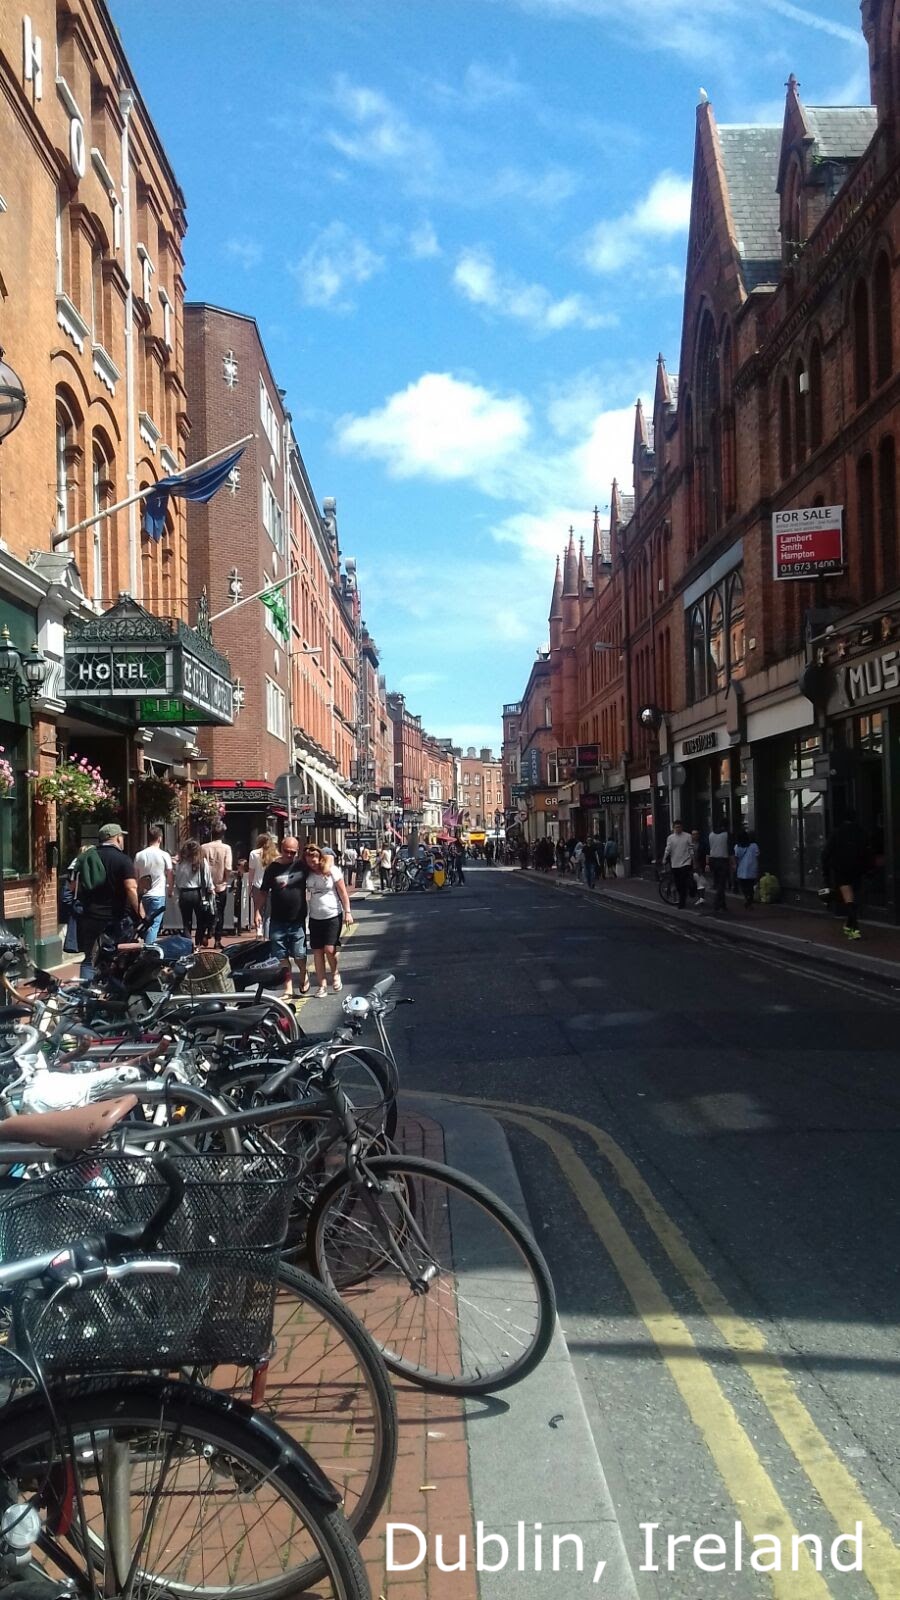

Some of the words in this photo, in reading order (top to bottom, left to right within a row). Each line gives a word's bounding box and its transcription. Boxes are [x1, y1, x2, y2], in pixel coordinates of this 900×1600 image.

[775, 512, 799, 524] FOR
[803, 508, 832, 521] SALE
[780, 534, 813, 544] Lambert
[780, 543, 803, 552] Smith
[780, 551, 815, 560] Hampton
[780, 564, 791, 572] 01
[794, 562, 811, 571] 673
[79, 662, 147, 680] HOTEL
[184, 661, 209, 699] CENTRAL
